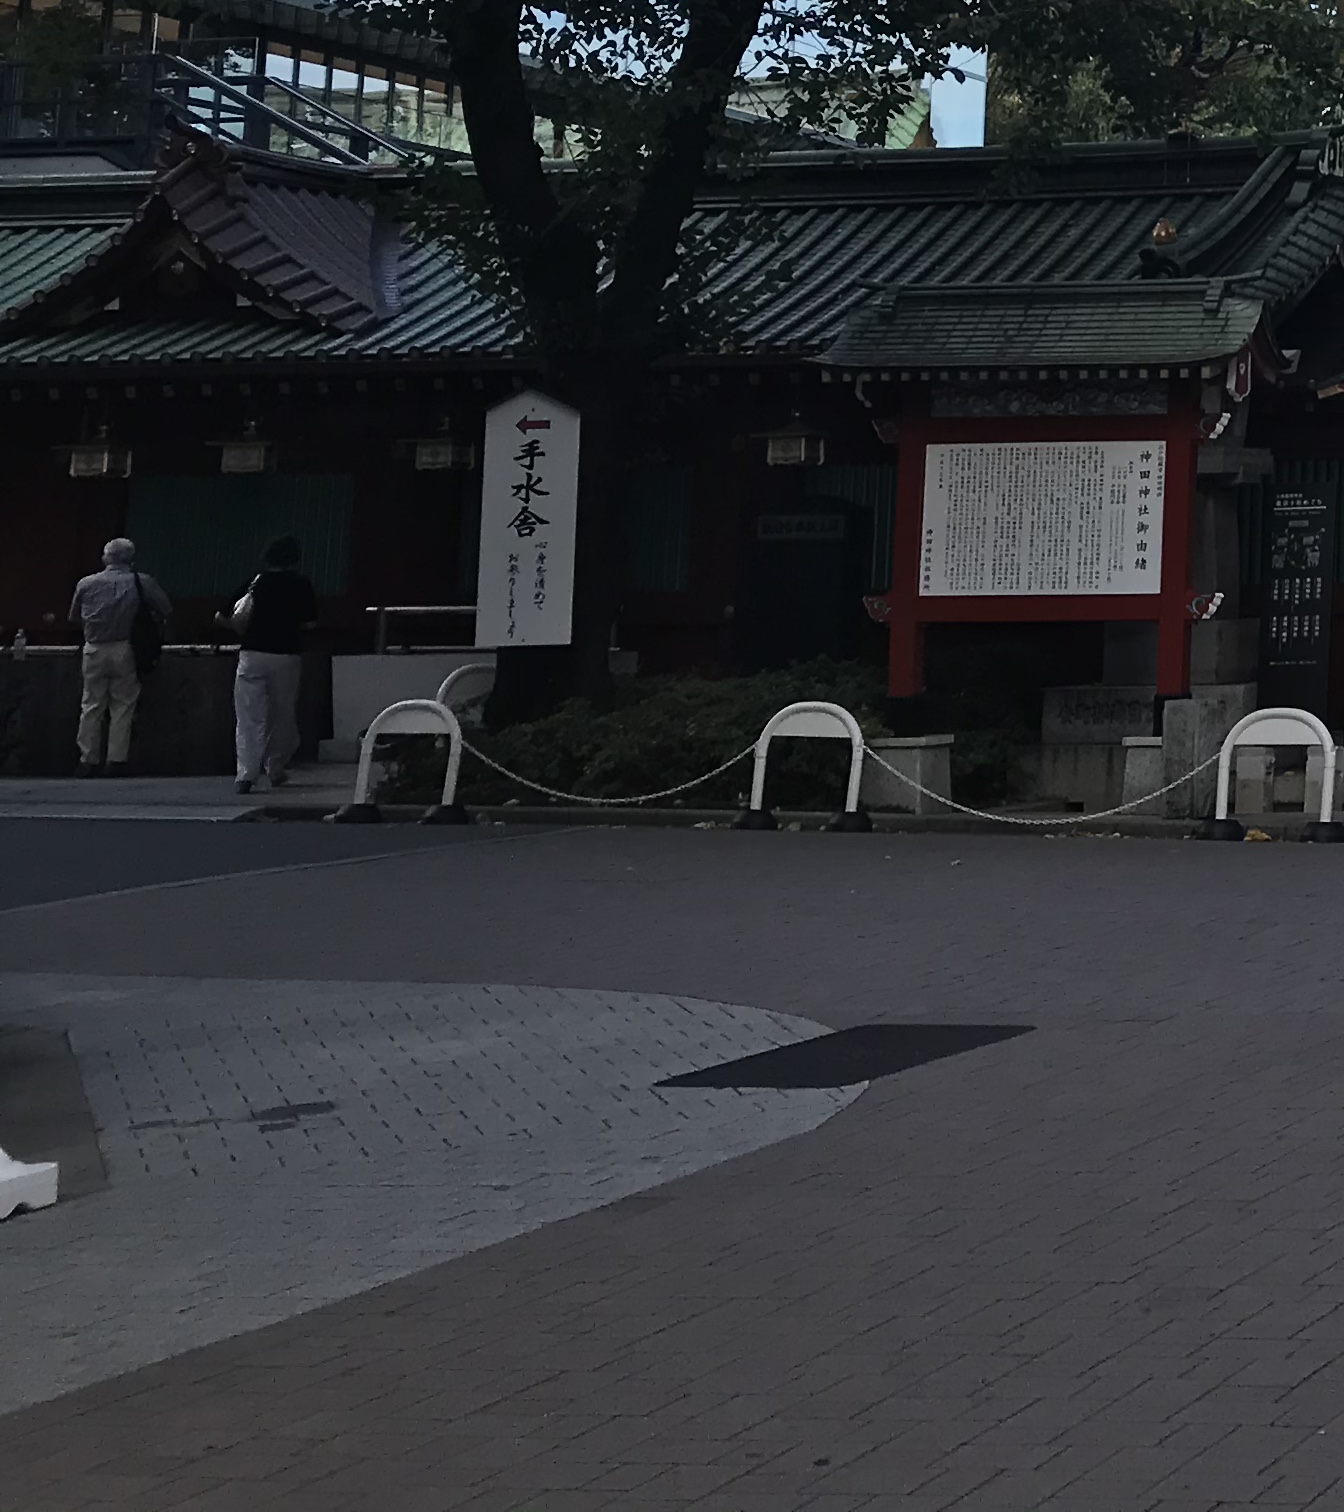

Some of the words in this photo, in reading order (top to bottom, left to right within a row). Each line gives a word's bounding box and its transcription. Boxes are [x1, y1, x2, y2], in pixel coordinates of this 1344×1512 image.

[507, 439, 551, 537] 手水舎
[1134, 450, 1152, 570] 神田神社御由緒
